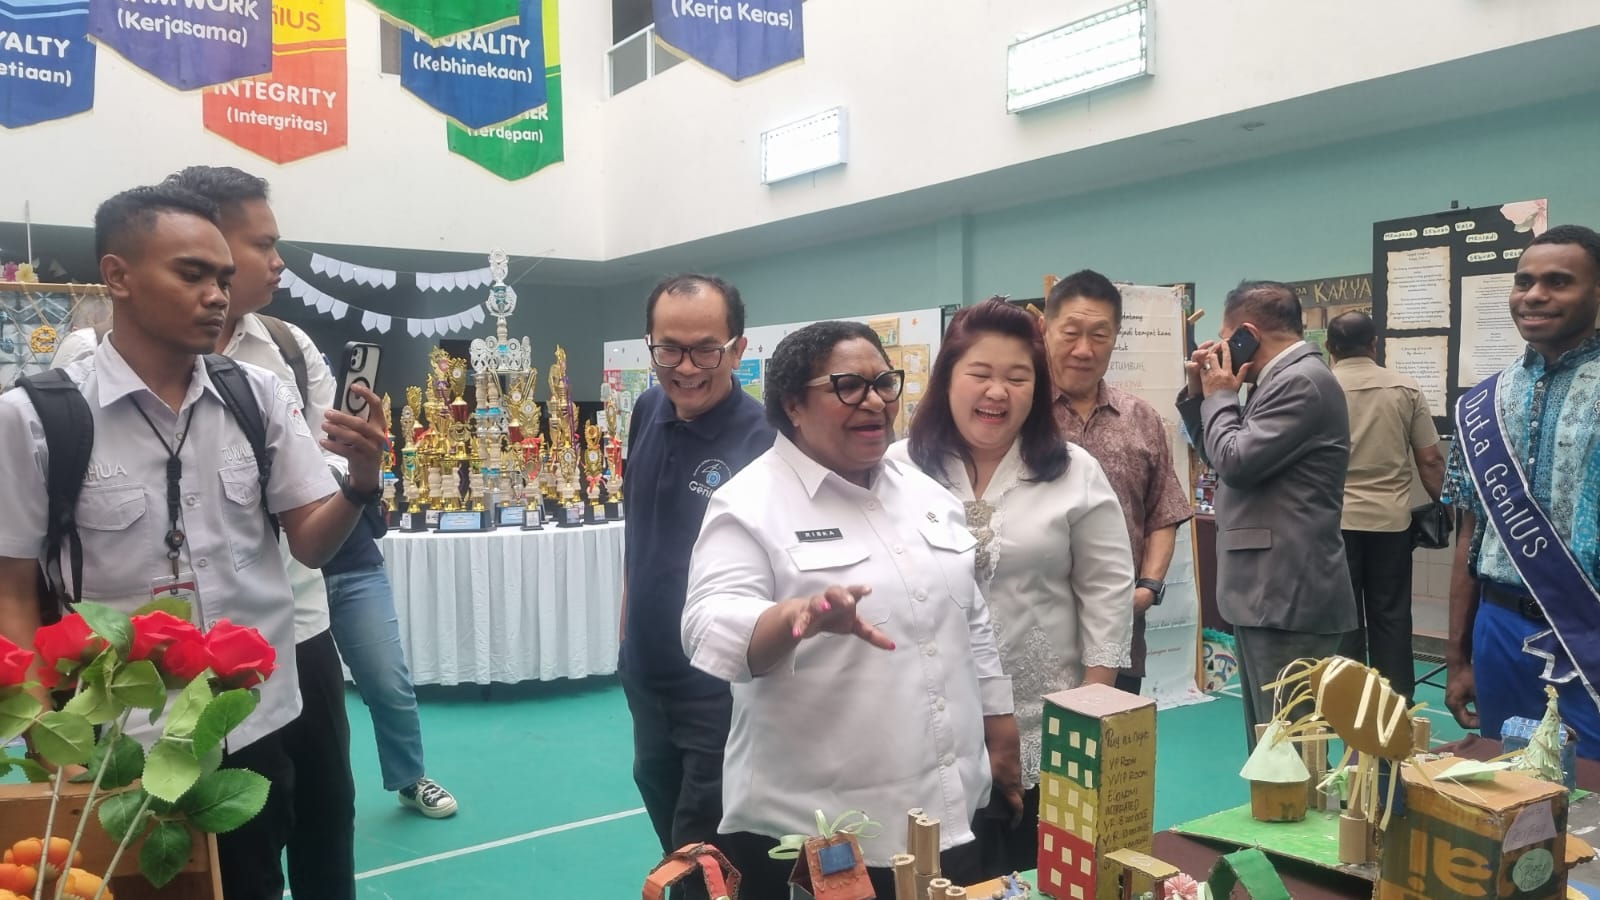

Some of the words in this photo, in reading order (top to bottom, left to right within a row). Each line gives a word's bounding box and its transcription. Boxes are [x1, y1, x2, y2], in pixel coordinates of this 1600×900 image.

[117, 7, 248, 49] (Kerjasama)
[671, 0, 733, 24] (Kerja
[738, 2, 793, 31] Keras)
[413, 28, 531, 59] RALITY
[0, 61, 72, 88] etiaan)
[413, 51, 533, 83] (Kebhinekaan)
[226, 106, 328, 135] (Intergritas)
[1314, 277, 1372, 303] KARYA
[1464, 387, 1492, 457] Duta
[1483, 462, 1548, 559] GenIUS
